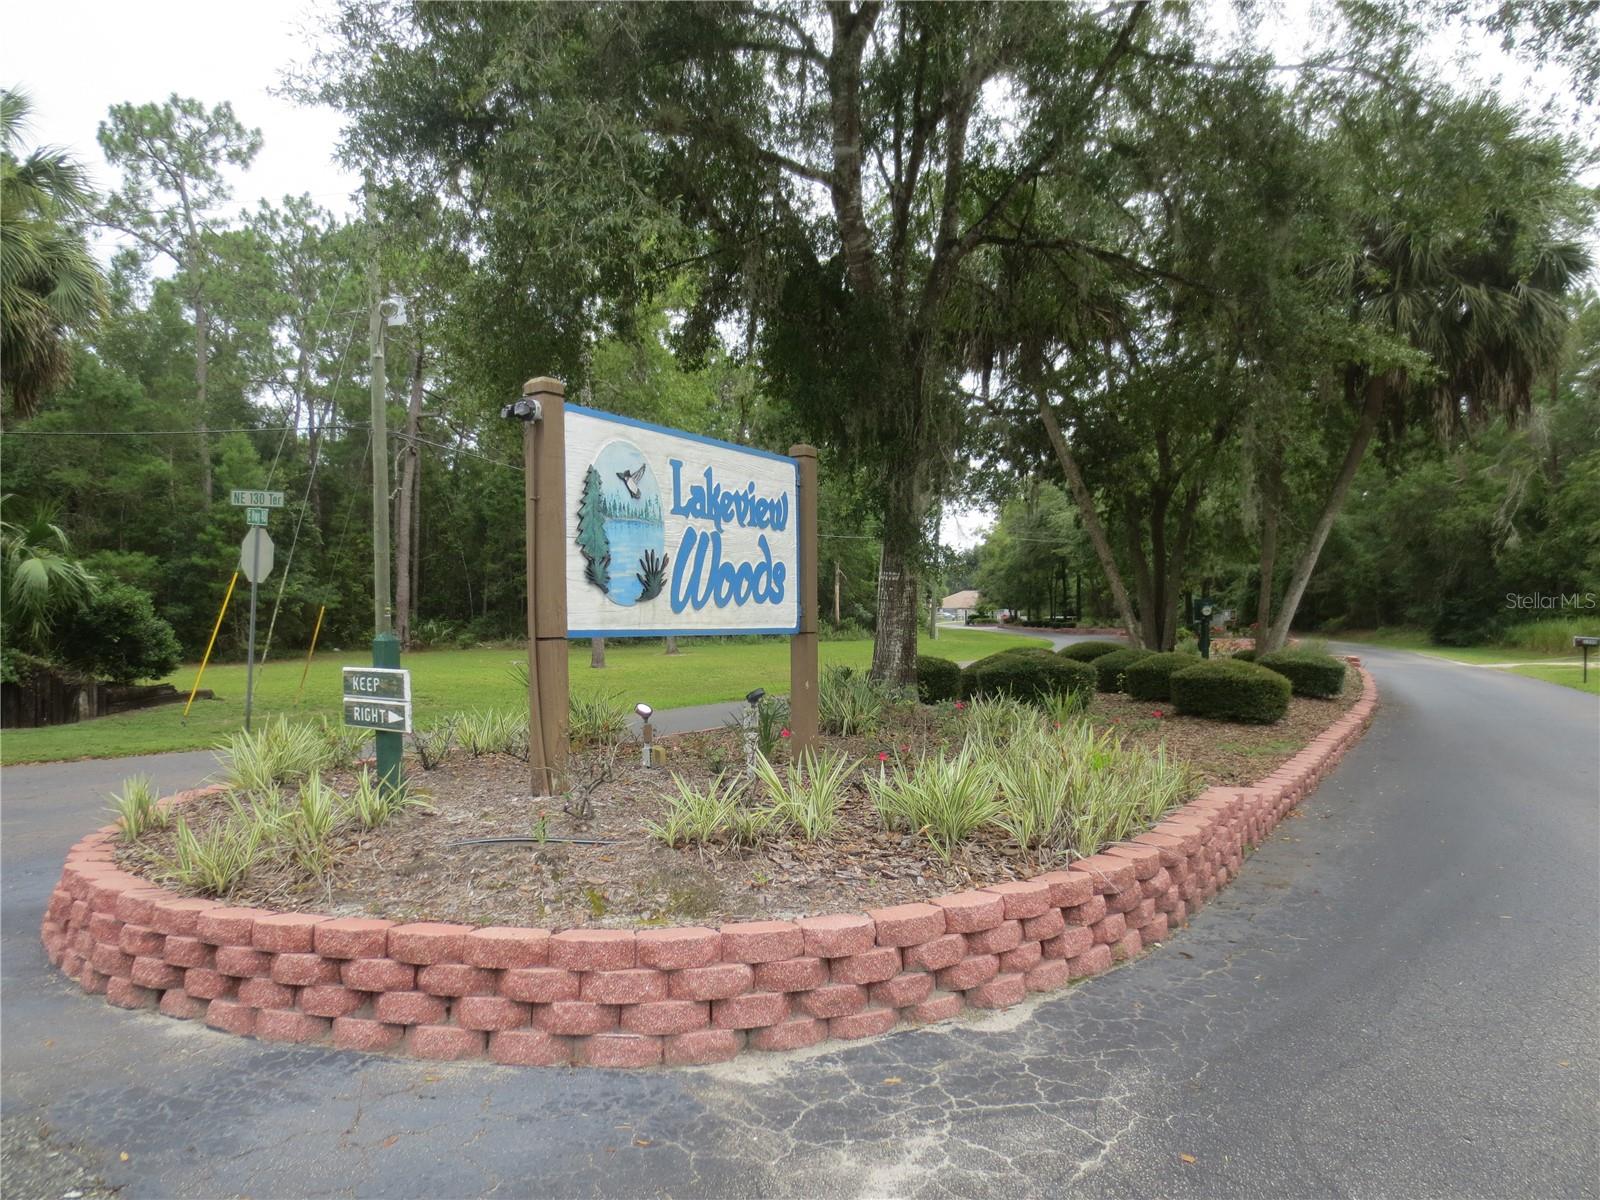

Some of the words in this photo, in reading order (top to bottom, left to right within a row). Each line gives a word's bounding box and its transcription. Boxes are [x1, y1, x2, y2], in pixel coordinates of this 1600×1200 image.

[233, 492, 246, 504] NE
[249, 492, 265, 505] 130
[269, 494, 281, 505] Ter
[669, 458, 788, 533] Lakeview
[670, 526, 786, 614] Woods
[352, 676, 380, 692] KEEP
[353, 706, 386, 724] RIGHT
